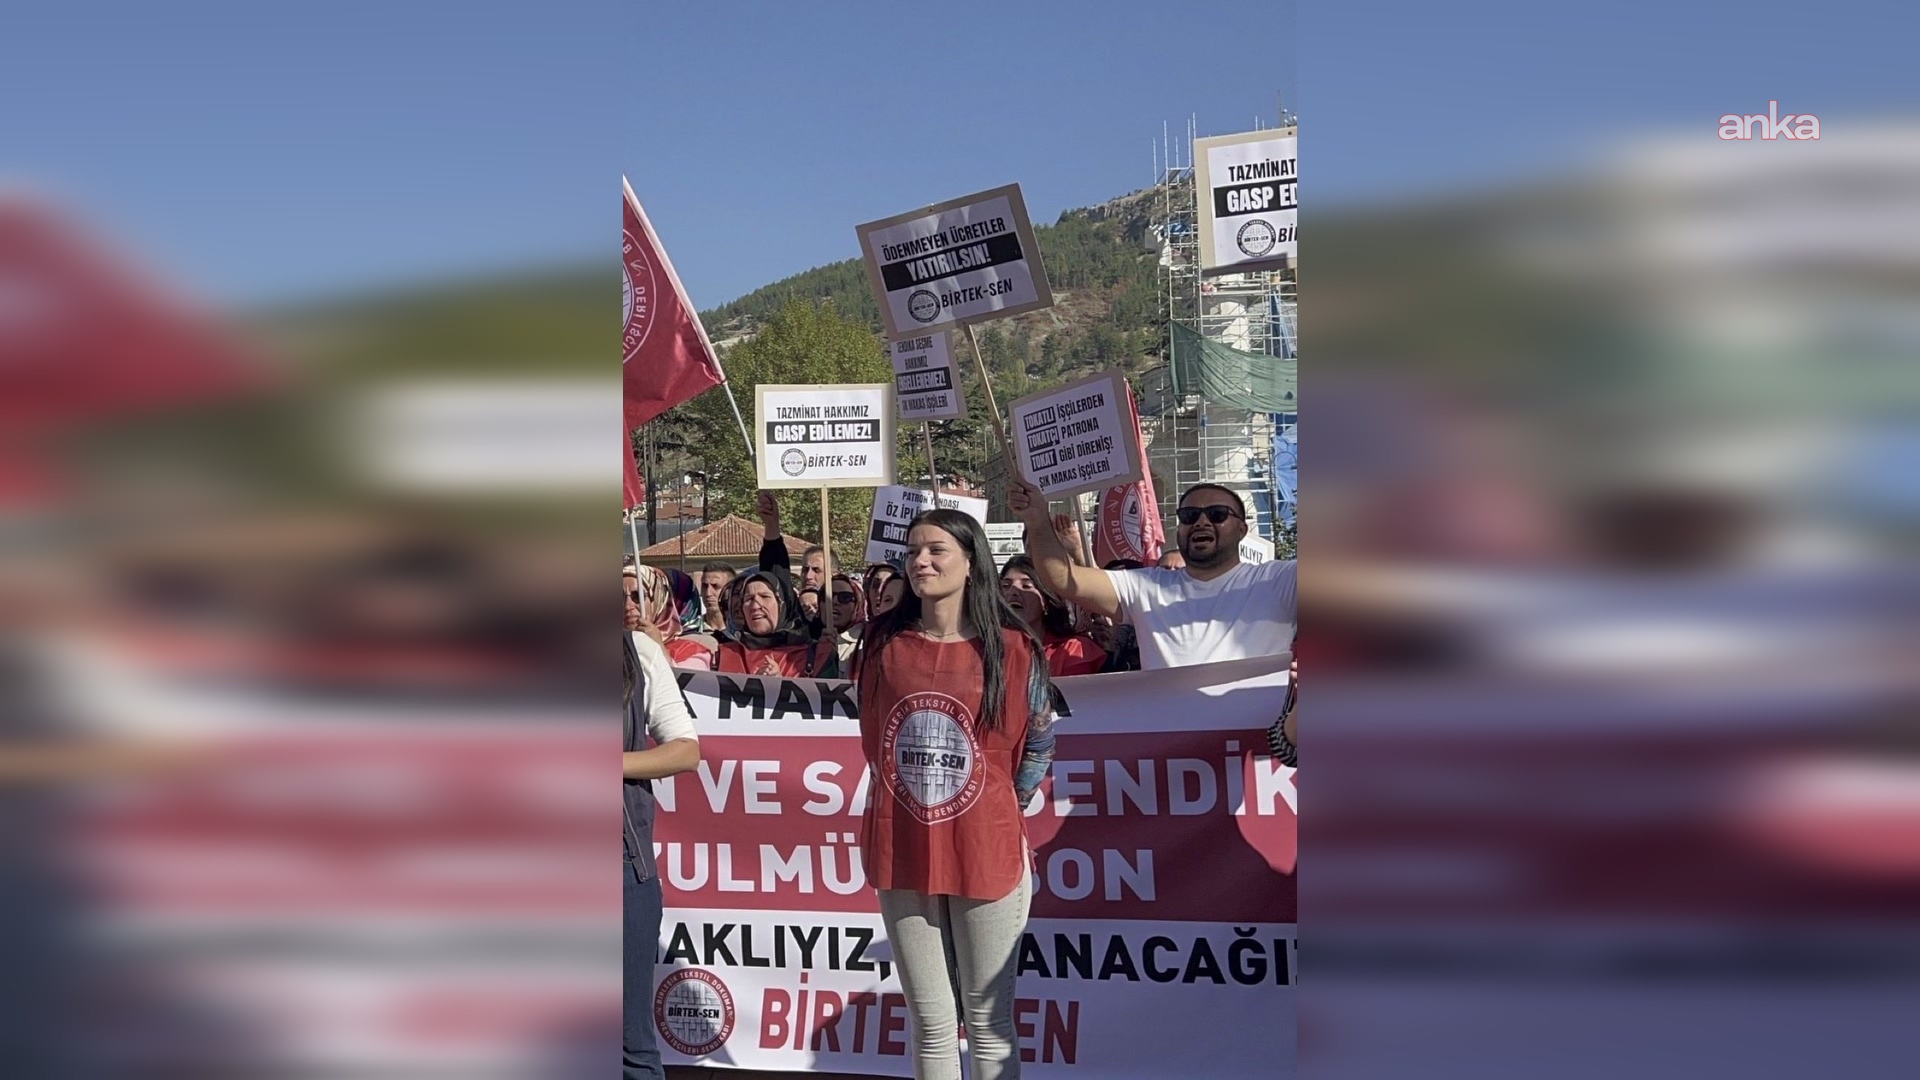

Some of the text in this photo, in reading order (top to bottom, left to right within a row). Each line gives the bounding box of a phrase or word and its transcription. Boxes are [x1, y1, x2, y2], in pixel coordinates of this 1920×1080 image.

[1228, 158, 1297, 182] TAZMİNAT
[1226, 186, 1274, 213] GASP
[881, 217, 1006, 261] ÖDENMEYEN ÜCRETLER
[1278, 223, 1297, 243] Bİ
[906, 242, 992, 282] YATIRILSIN!
[941, 278, 1013, 308] BİRTEK-SEN
[776, 404, 869, 419] TAZMİNAT HAKKIMIZ
[1024, 393, 1104, 430] TOKATLI İŞÇİLERDEN
[774, 421, 872, 442] GASP EDİLEMEZ!
[1028, 417, 1099, 449] TOKATÇI PATRONA
[808, 454, 867, 467] BİRTEK-SEN
[1031, 436, 1114, 470] TOKAT GİBİ DİRENİŞ!
[1039, 457, 1110, 491] ŞIK MAKAS İŞÇİLERİ
[886, 501, 899, 518] ÖZ
[902, 491, 928, 503] PATRON
[1240, 544, 1263, 564] KLIYIZ
[717, 676, 858, 719] MAK
[902, 747, 966, 770] BİRTEK-SEN
[697, 760, 782, 814] VE
[653, 832, 866, 895] ULMÜ
[655, 922, 1297, 986] AKLIYIZ, ANACAĞI
[680, 971, 710, 982] TEKSTİL
[711, 979, 732, 1011] DOKUMA
[668, 1004, 719, 1019] BİRTEK-SEN
